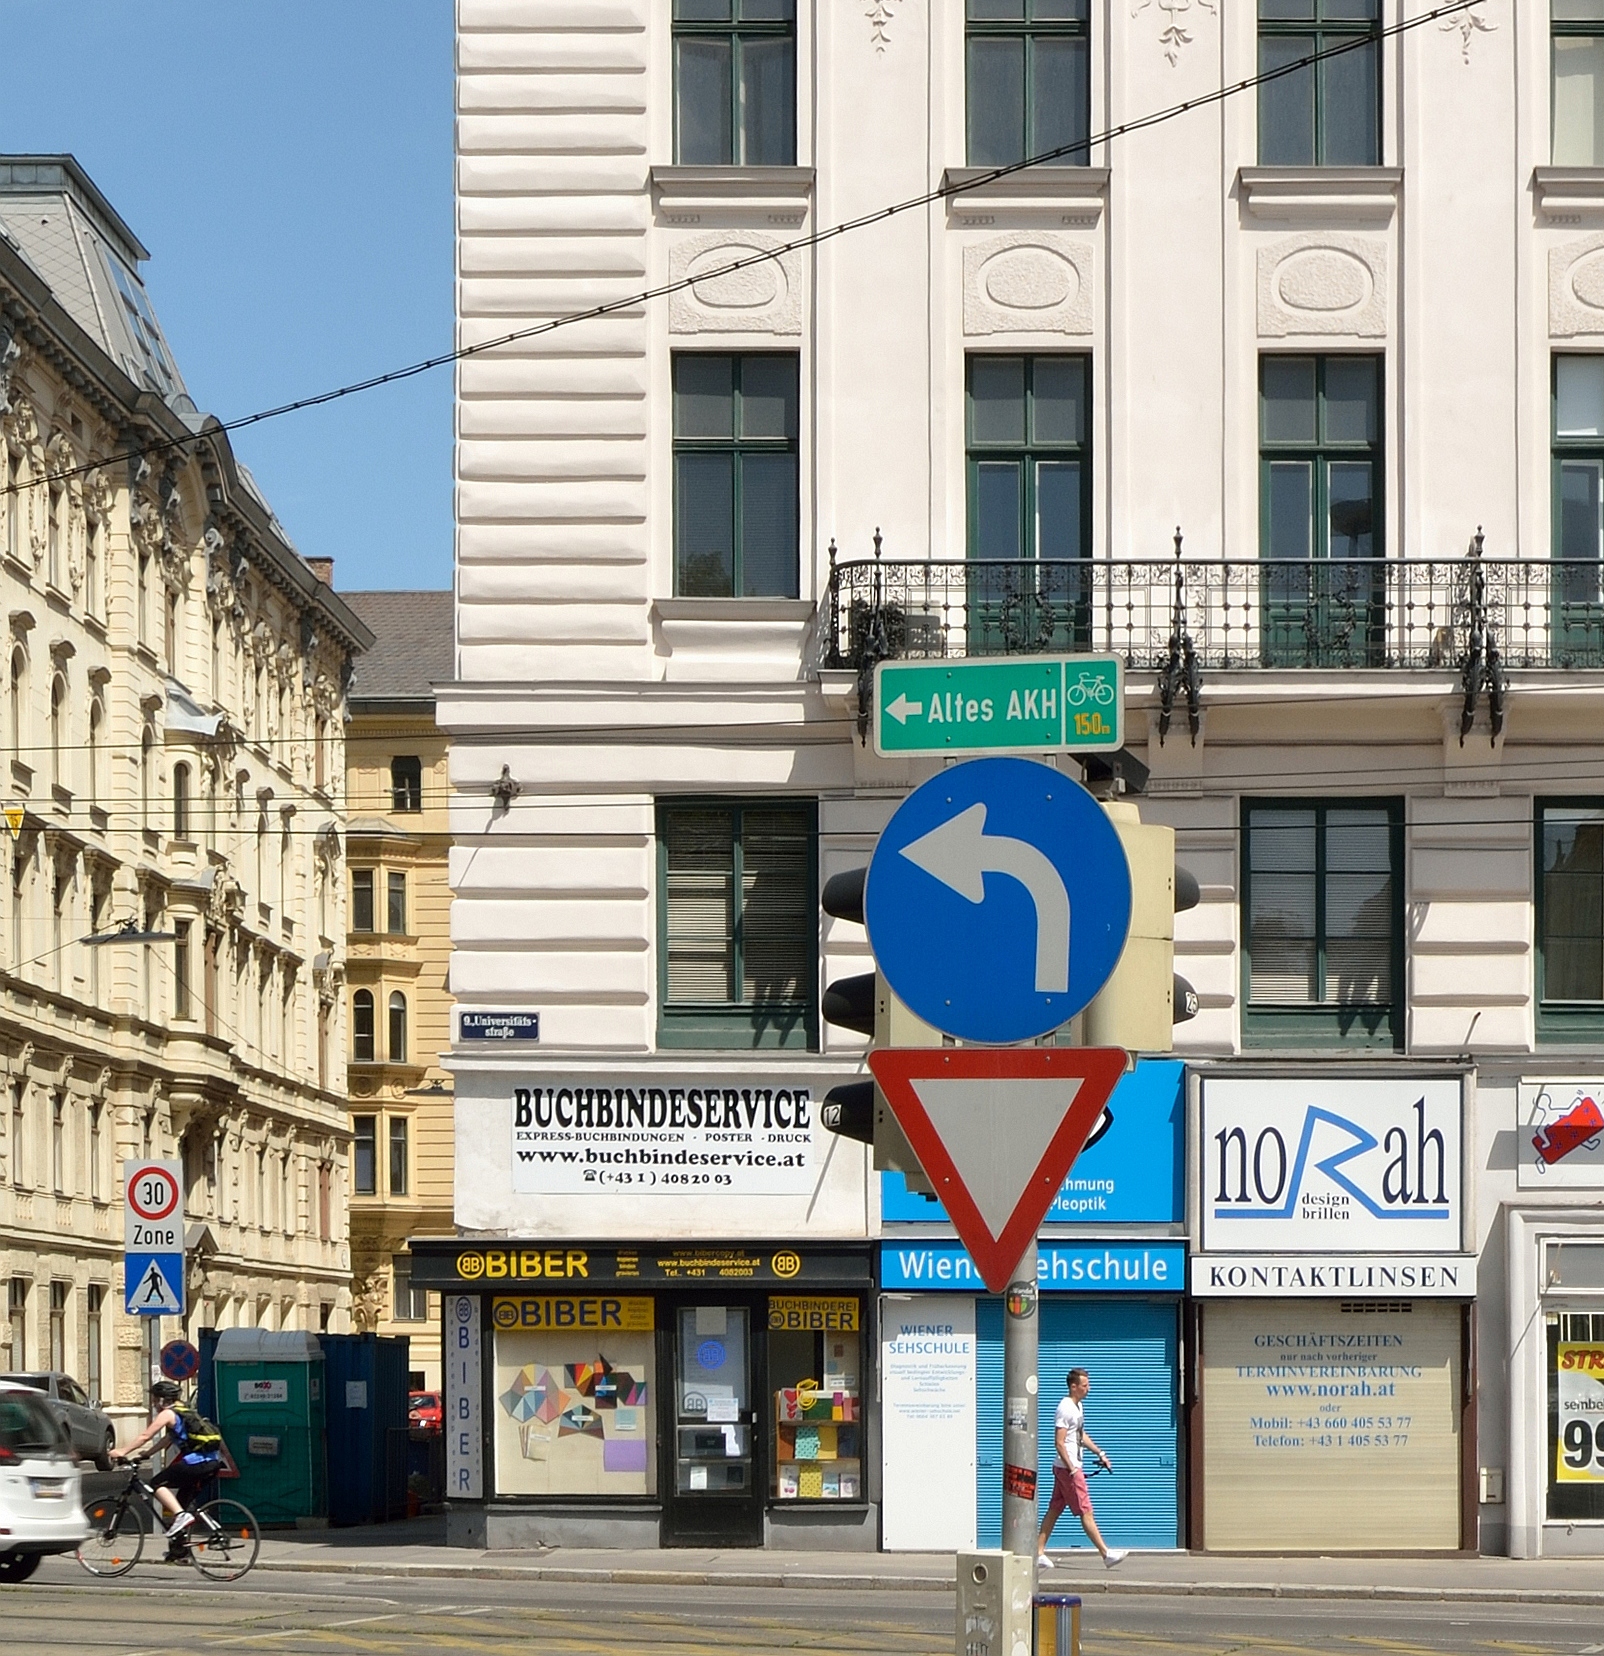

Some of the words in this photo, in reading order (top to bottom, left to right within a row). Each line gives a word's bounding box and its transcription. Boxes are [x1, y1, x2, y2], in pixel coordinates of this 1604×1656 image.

[928, 693, 994, 723] Altes
[1006, 688, 1057, 721] AKH
[485, 1026, 515, 1039] straße
[514, 1088, 811, 1129] BUCHBINDESERVICE
[824, 1106, 841, 1126] 12
[516, 1131, 685, 1142] EXPRESS-BUCHBINDUNGEN
[704, 1132, 753, 1142] POSTER
[516, 1148, 806, 1168] www.buchbindeservice.at
[1062, 1177, 1114, 1194] hmung
[143, 1183, 165, 1207] 30
[1301, 1192, 1350, 1207] design
[1302, 1207, 1350, 1220] brillen
[133, 1225, 176, 1247] Zone
[486, 1250, 589, 1278] BIBER
[898, 1251, 979, 1280] Wien
[1037, 1249, 1168, 1280] ehschule
[1209, 1265, 1459, 1288] KONTAKTLINSEN
[521, 1300, 622, 1327] BIBER
[769, 1299, 857, 1311] BUCHBINDEREI
[787, 1311, 853, 1329] BIBER
[900, 1325, 954, 1336] WIENER
[1254, 1331, 1403, 1347] GESCHÄFTSZEITEN
[889, 1342, 970, 1354] SEHSCHULE
[1280, 1354, 1298, 1362] nur
[1300, 1351, 1324, 1362] nach
[1326, 1351, 1378, 1364] vorheriger
[1235, 1365, 1422, 1379] TERMINVEREINBARUNG
[1266, 1380, 1396, 1397] www.norah.at
[458, 1326, 470, 1491] BIBER
[1319, 1402, 1342, 1413] oder
[1250, 1416, 1293, 1429] Mobil:
[1297, 1417, 1321, 1429] +43
[1325, 1417, 1347, 1429] 660
[1351, 1417, 1374, 1429] 405
[1378, 1417, 1393, 1429] 53
[1396, 1417, 1412, 1429] 77
[1253, 1434, 1305, 1447] Telefon:
[1308, 1435, 1333, 1447] +43
[1347, 1435, 1370, 1447] 405
[1374, 1435, 1389, 1447] 53
[1393, 1435, 1408, 1447] 77
